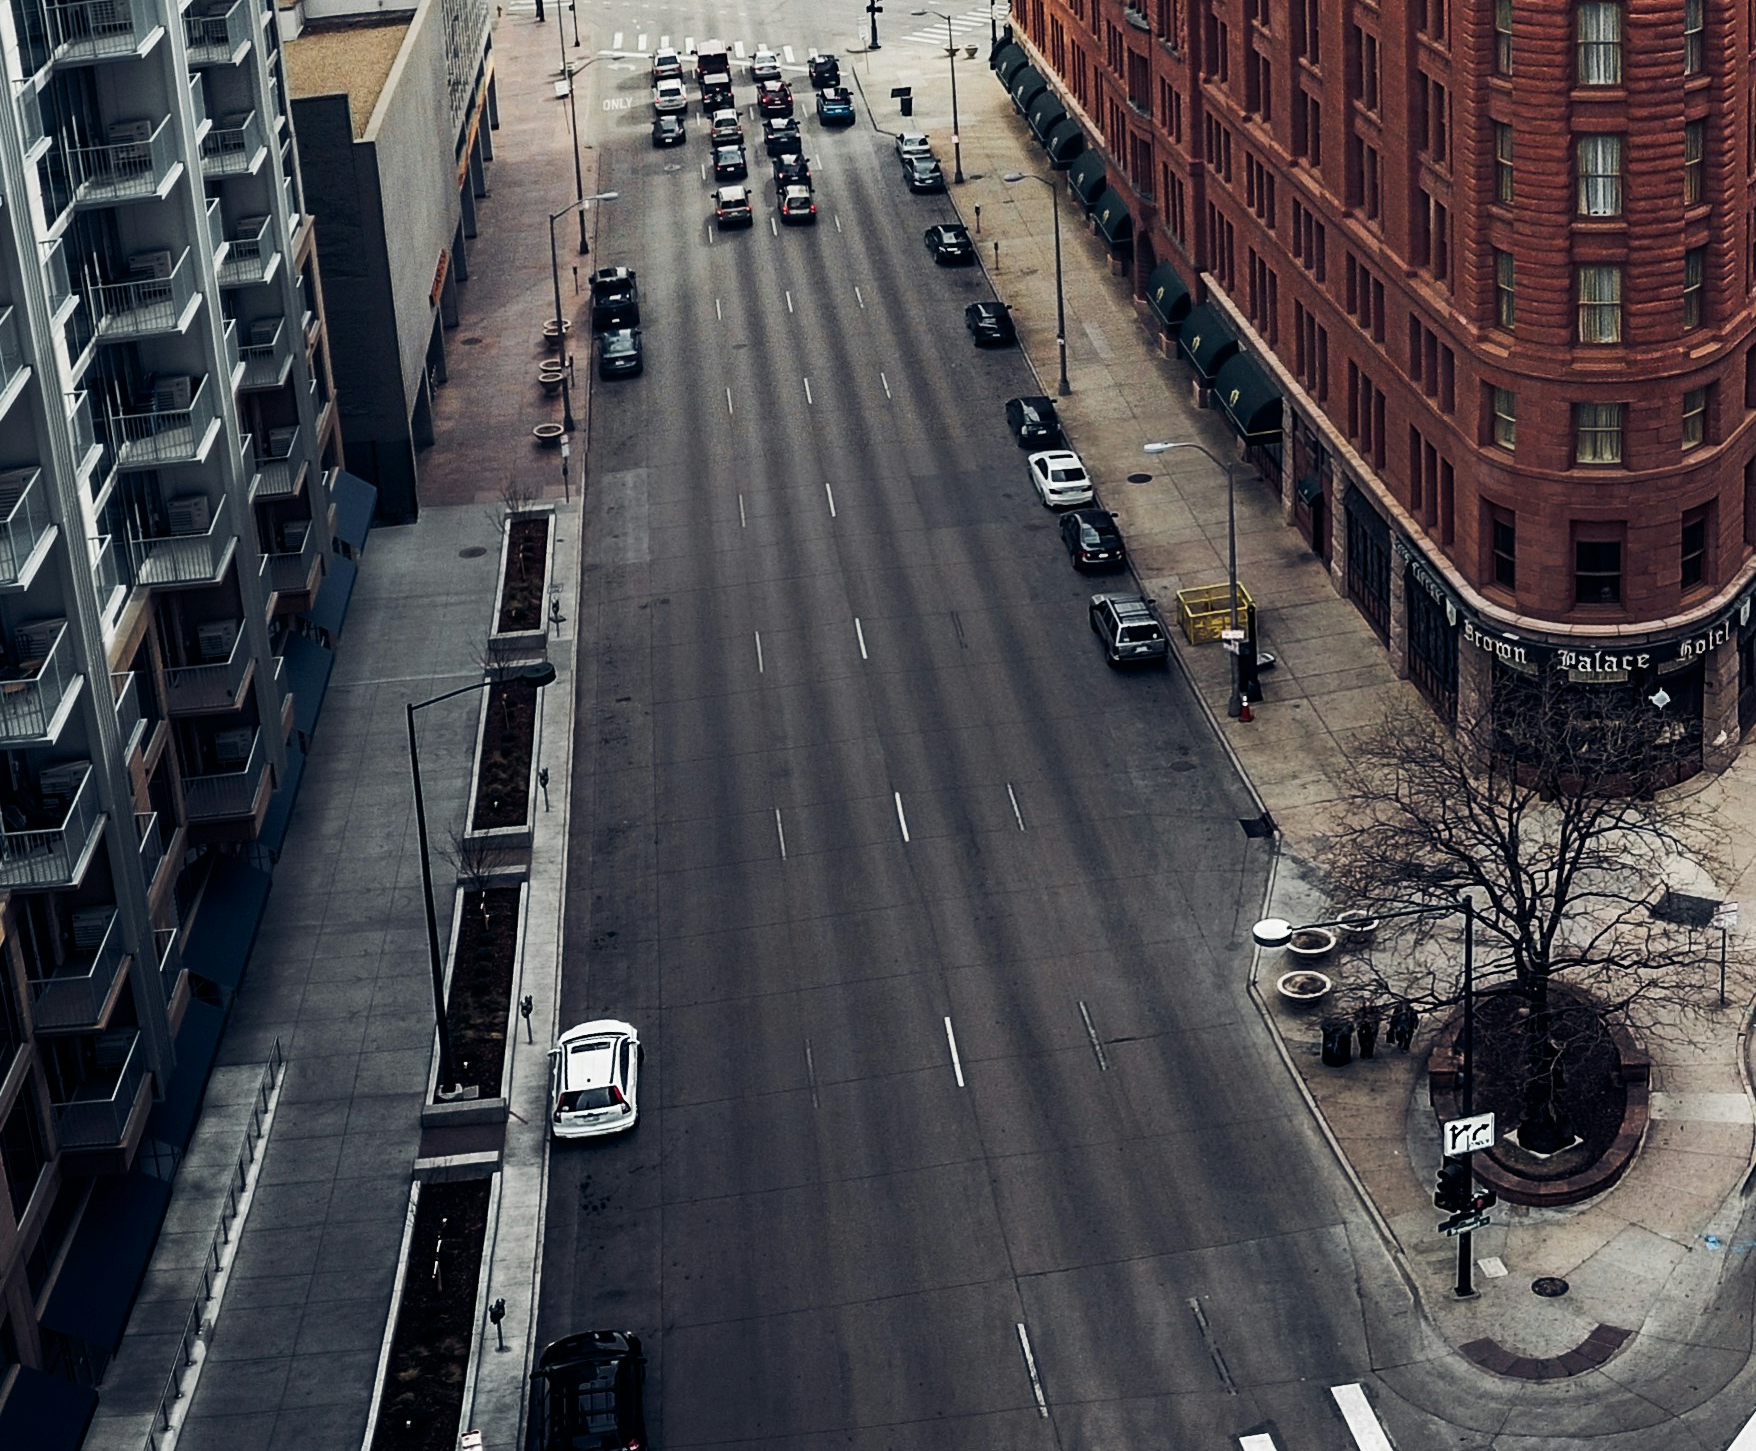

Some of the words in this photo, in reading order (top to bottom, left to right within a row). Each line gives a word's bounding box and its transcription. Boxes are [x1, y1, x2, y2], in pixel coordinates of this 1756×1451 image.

[602, 97, 633, 111] ONLY
[1463, 619, 1527, 664] Brown
[1556, 650, 1650, 673] Palace
[1676, 619, 1730, 661] Hotel
